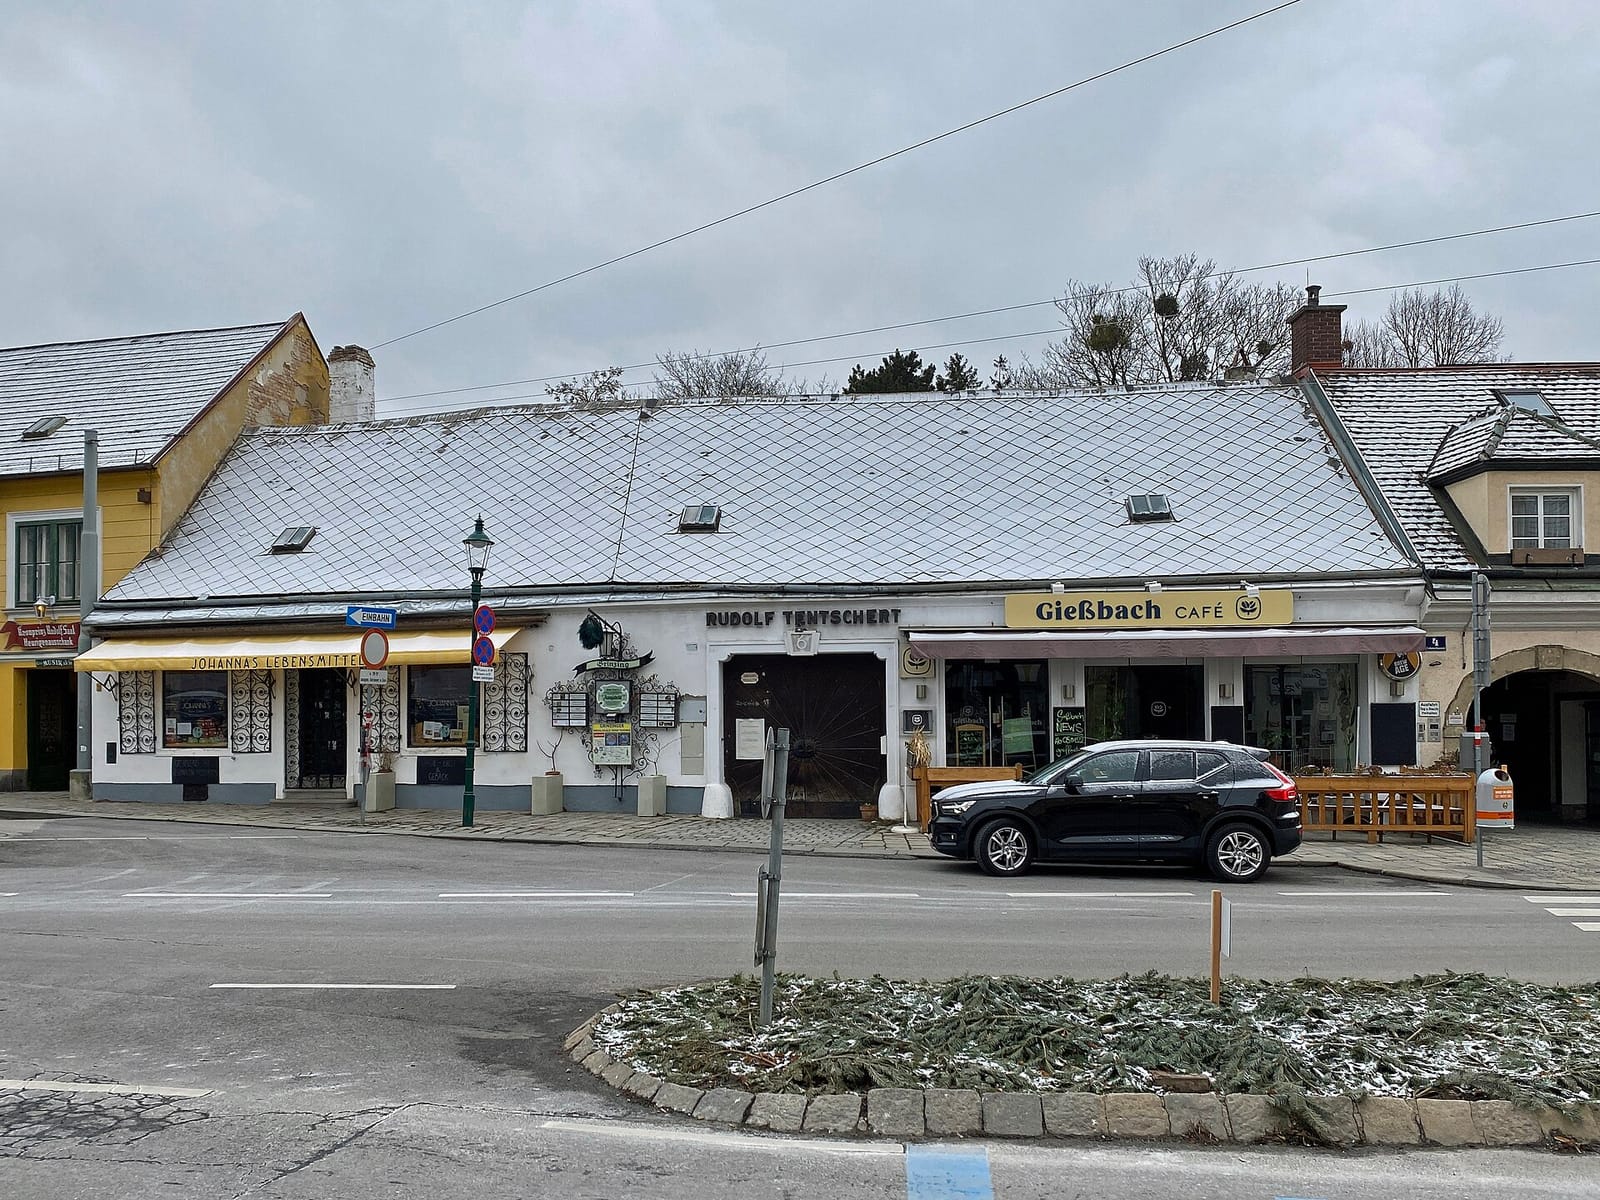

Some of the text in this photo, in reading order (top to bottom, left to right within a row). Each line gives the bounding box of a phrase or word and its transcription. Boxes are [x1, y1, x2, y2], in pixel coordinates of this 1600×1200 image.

[1036, 601, 1223, 620] Gießbach CAFÉ
[362, 612, 390, 623] EINBAHN
[706, 609, 901, 626] RUDOLF TENTSCHERT
[796, 636, 807, 650] 6
[1431, 637, 1439, 647] 4
[191, 654, 364, 669] JOHANNAS LEBENSMITTEL
[1394, 664, 1410, 675] AGE
[1056, 722, 1084, 733] NEWS
